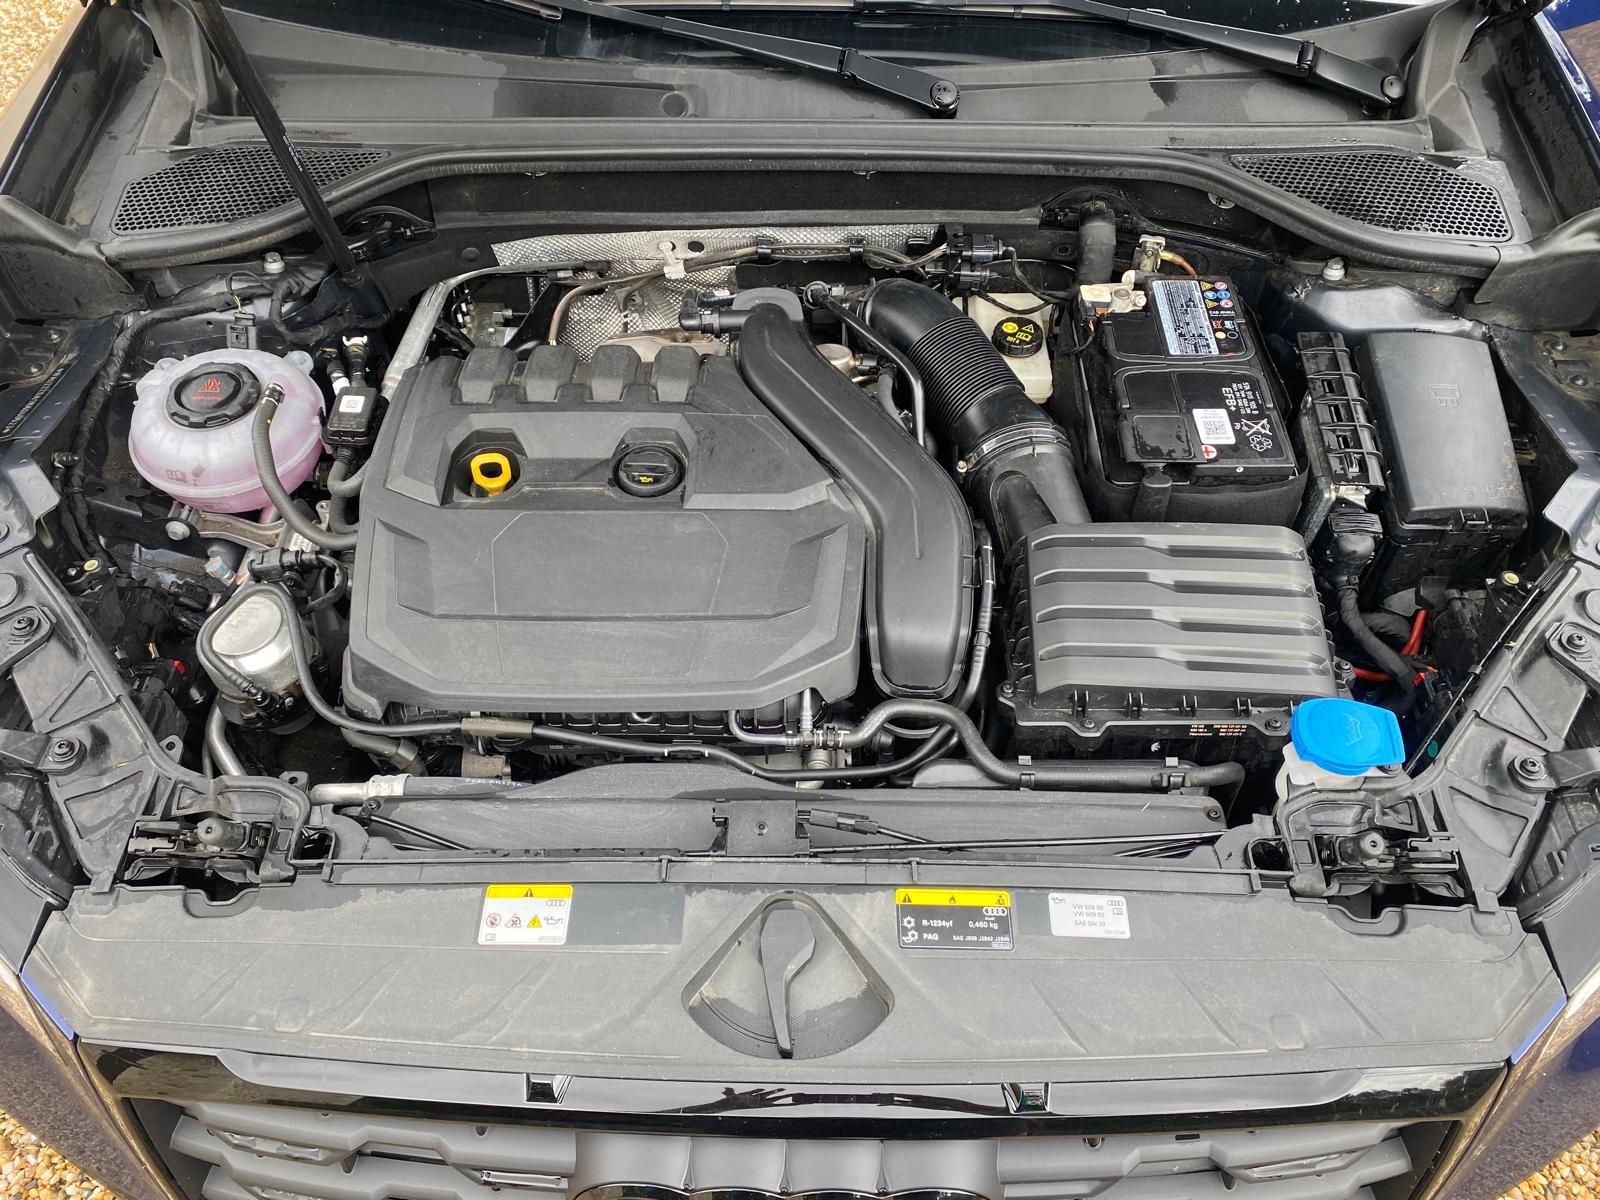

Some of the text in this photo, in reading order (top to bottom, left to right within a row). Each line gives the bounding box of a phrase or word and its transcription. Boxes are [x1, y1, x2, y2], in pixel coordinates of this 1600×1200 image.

[1222, 388, 1236, 411] EFB+
[922, 919, 953, 928] R-1234yf
[989, 920, 998, 930] kg
